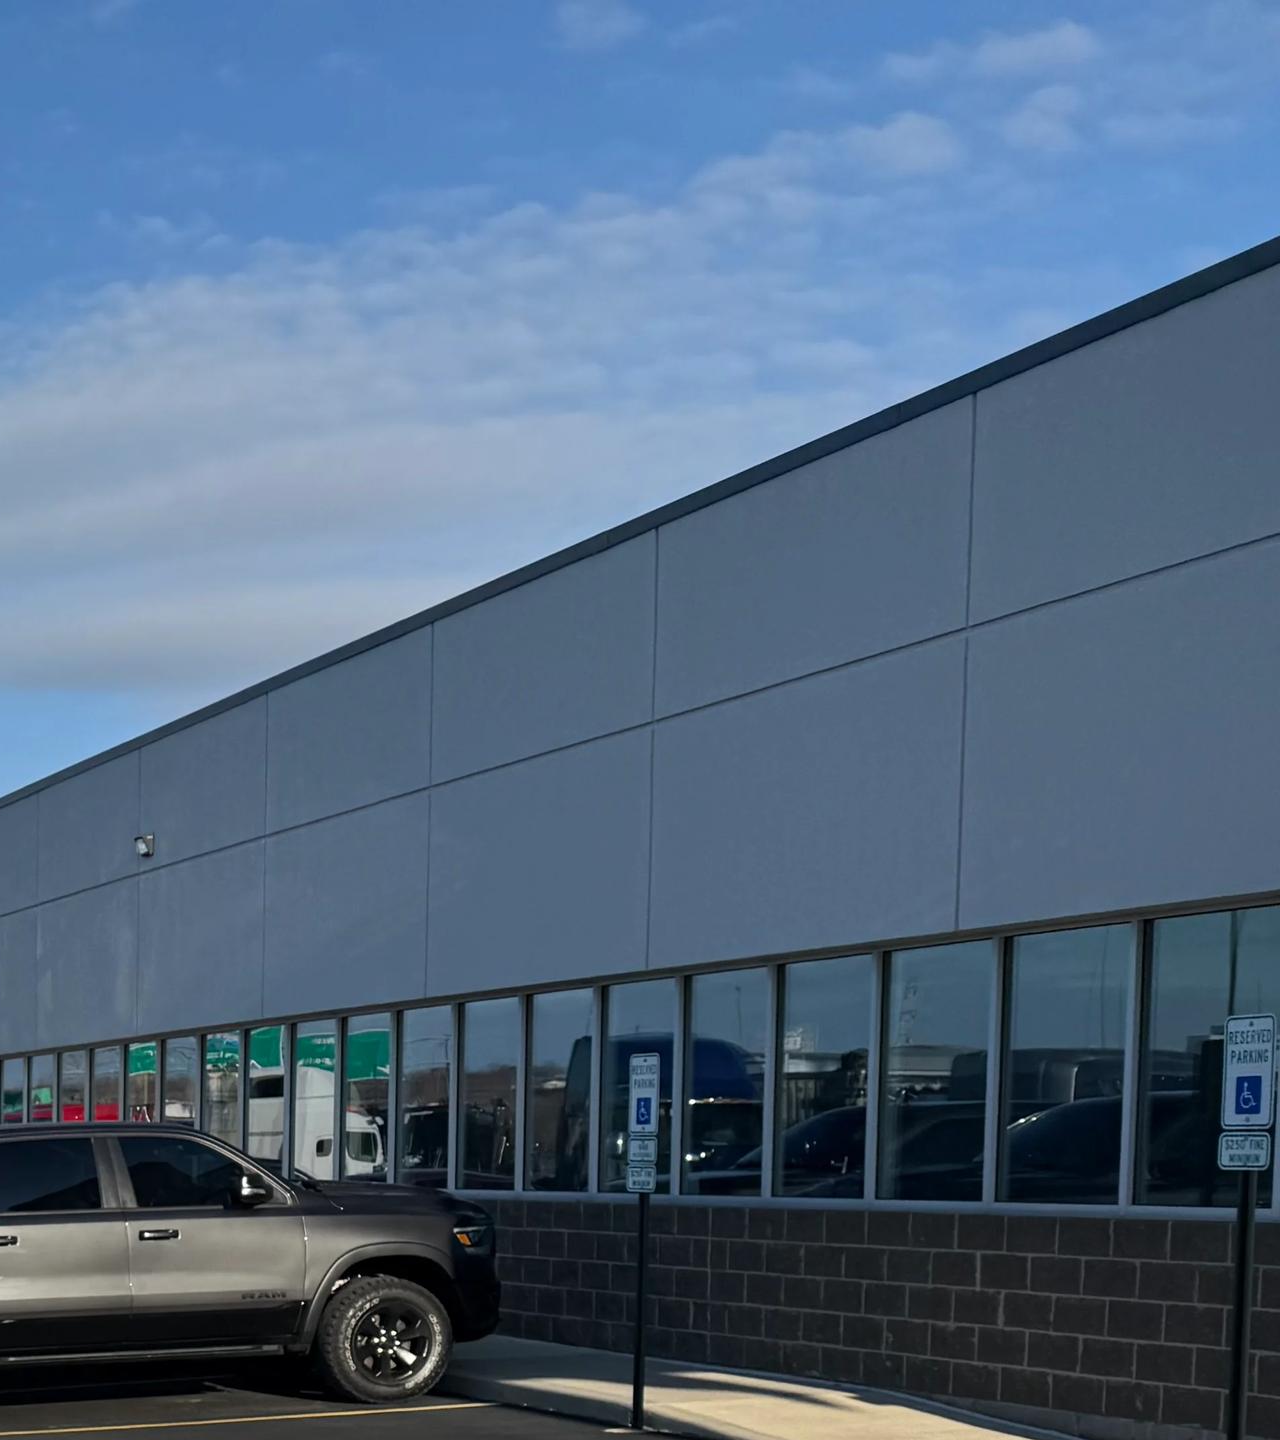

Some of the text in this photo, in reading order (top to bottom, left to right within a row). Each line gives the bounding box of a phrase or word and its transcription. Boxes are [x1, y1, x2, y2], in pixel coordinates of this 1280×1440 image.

[1228, 1029, 1272, 1045] RESERVED
[1230, 1049, 1269, 1064] PARKING
[1249, 1138, 1266, 1151] FINE
